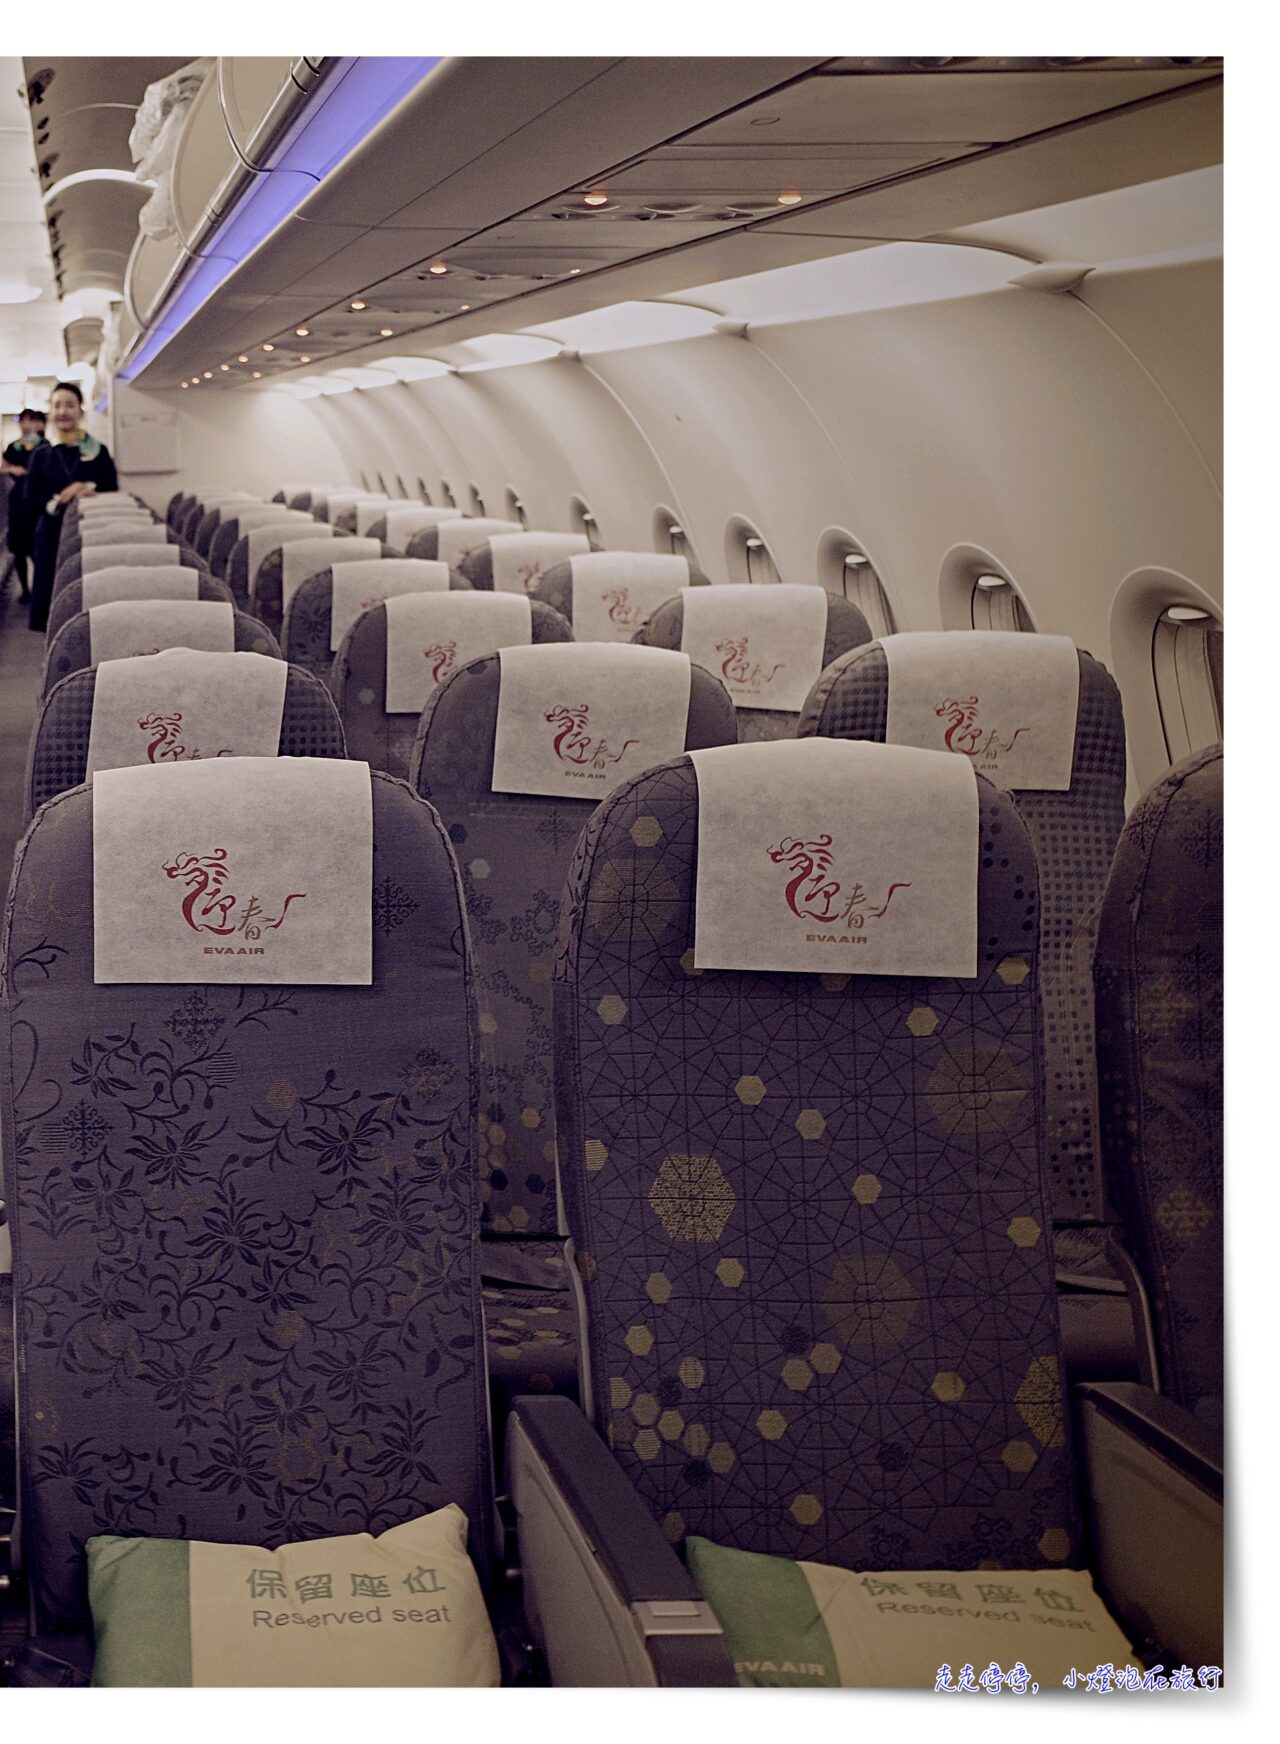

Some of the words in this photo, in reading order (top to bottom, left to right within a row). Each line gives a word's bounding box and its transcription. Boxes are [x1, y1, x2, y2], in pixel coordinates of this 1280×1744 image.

[246, 1565, 446, 1604] 保留座位
[252, 1606, 382, 1628] Reserved
[392, 1604, 452, 1623] seat
[876, 1601, 1021, 1623] Reserved
[1031, 1613, 1095, 1632] seat
